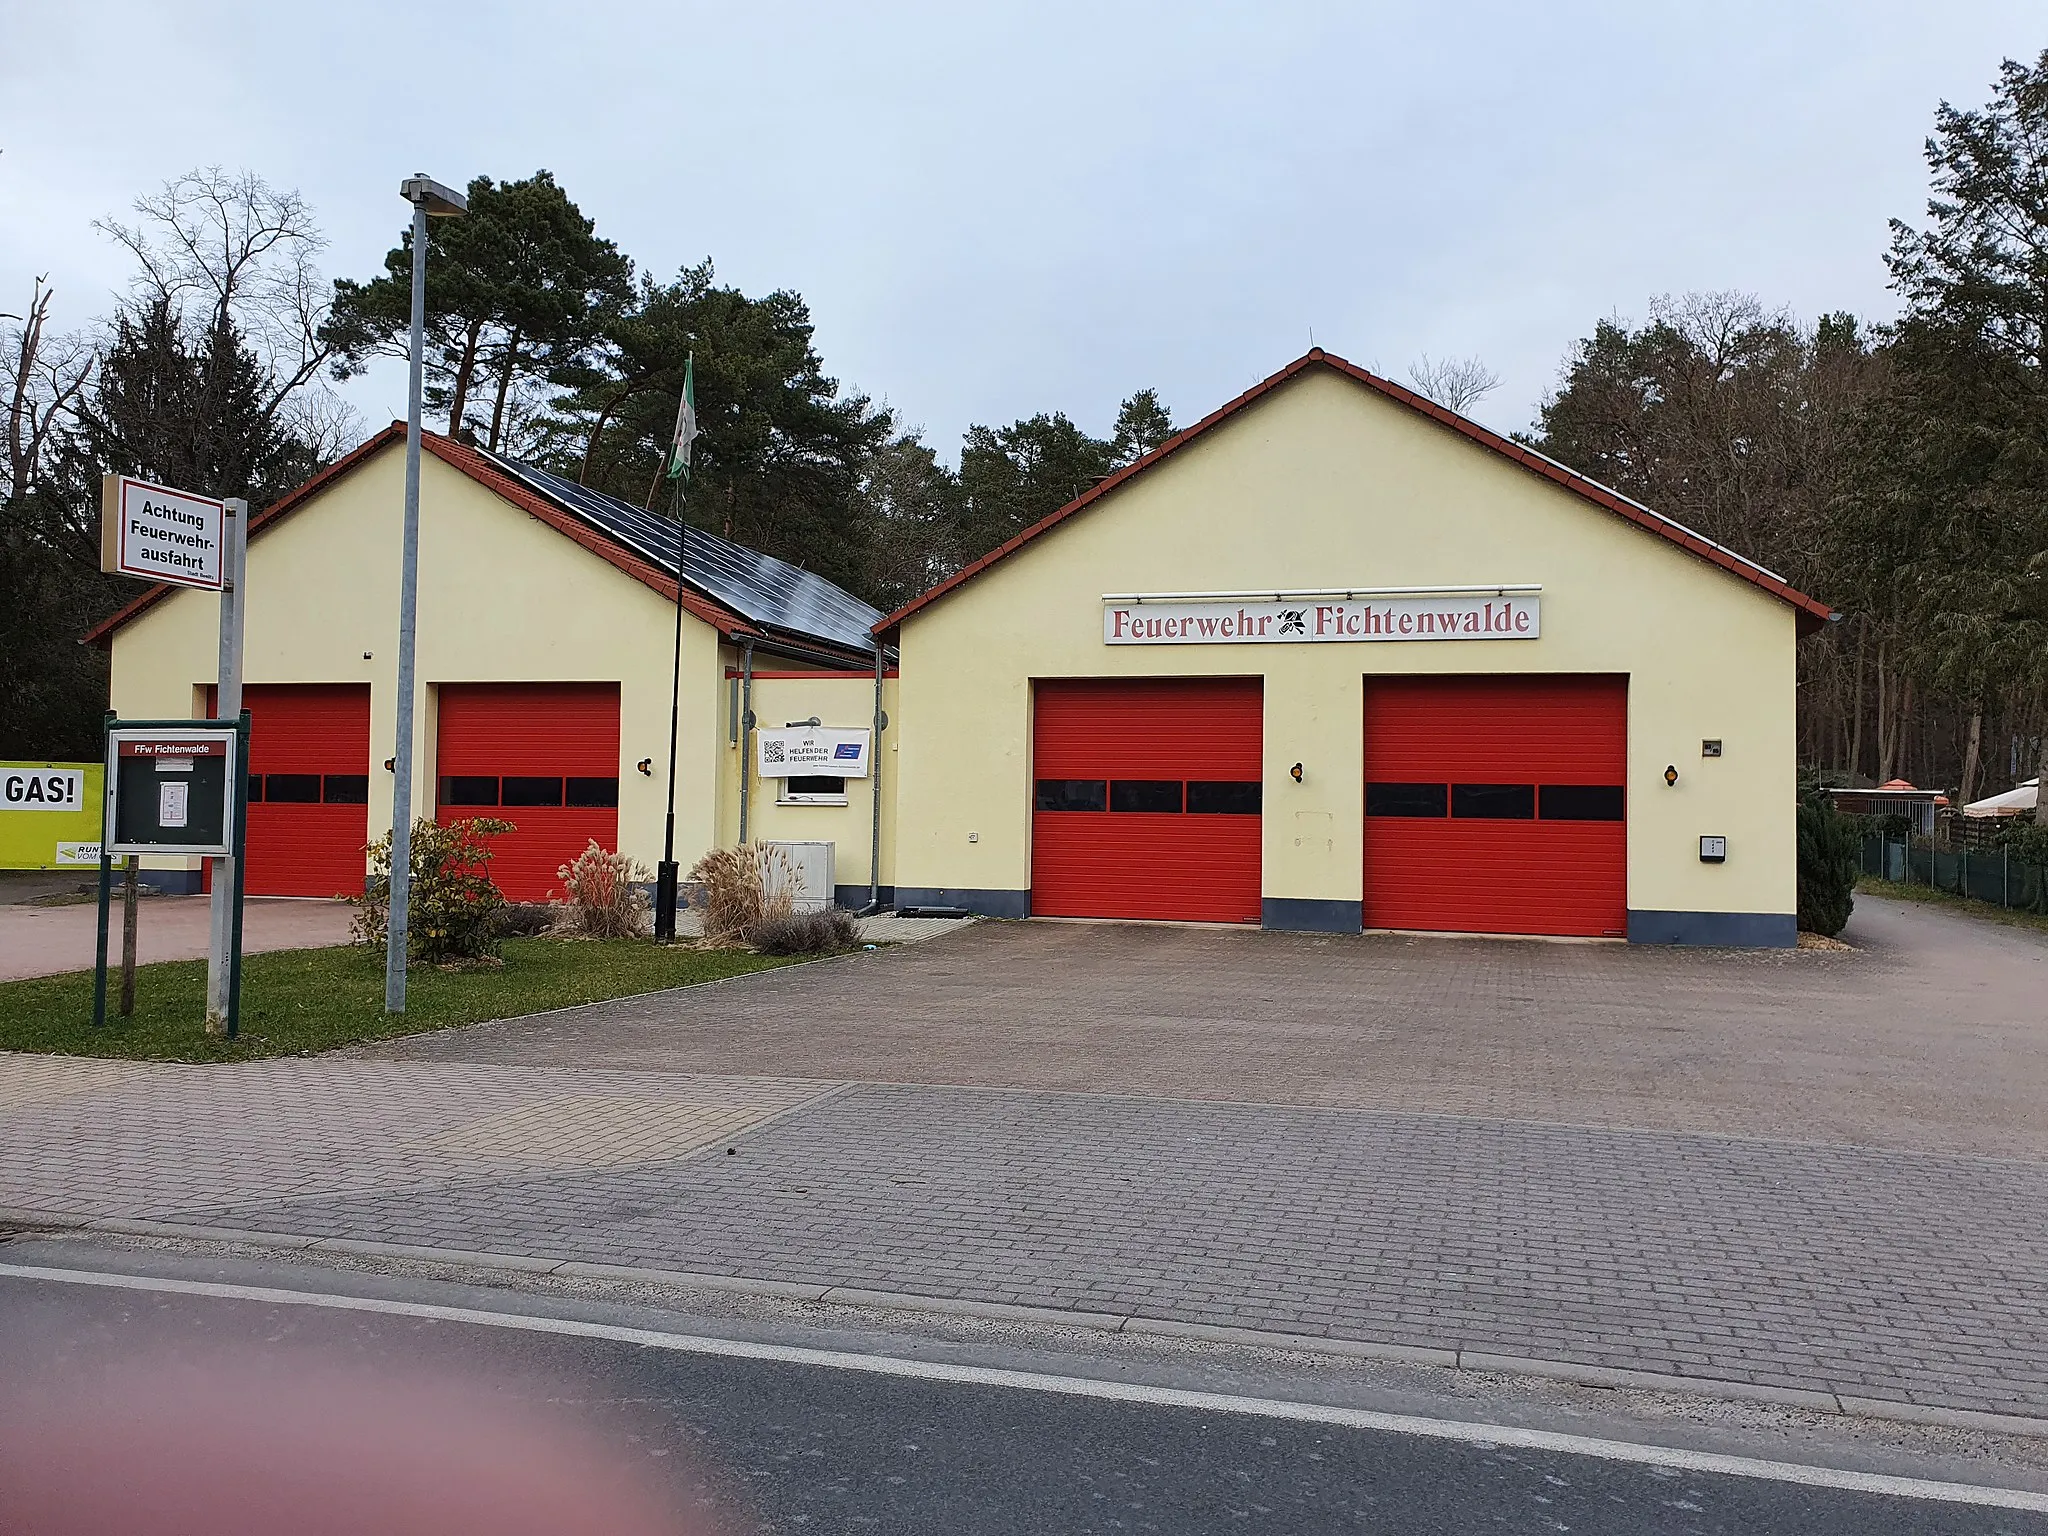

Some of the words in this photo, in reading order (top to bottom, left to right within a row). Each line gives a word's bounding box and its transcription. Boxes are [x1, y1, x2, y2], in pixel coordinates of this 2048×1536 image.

[142, 501, 204, 531] Achtung
[130, 520, 215, 550] Feuerwehr-
[141, 547, 204, 570] ausfahrt
[1113, 608, 1273, 639] Feuerwehr
[1315, 602, 1530, 636] Fichtenwalde
[134, 744, 153, 754] FFw
[154, 744, 210, 754] Fichtenwalde
[5, 775, 75, 803] GAS!
